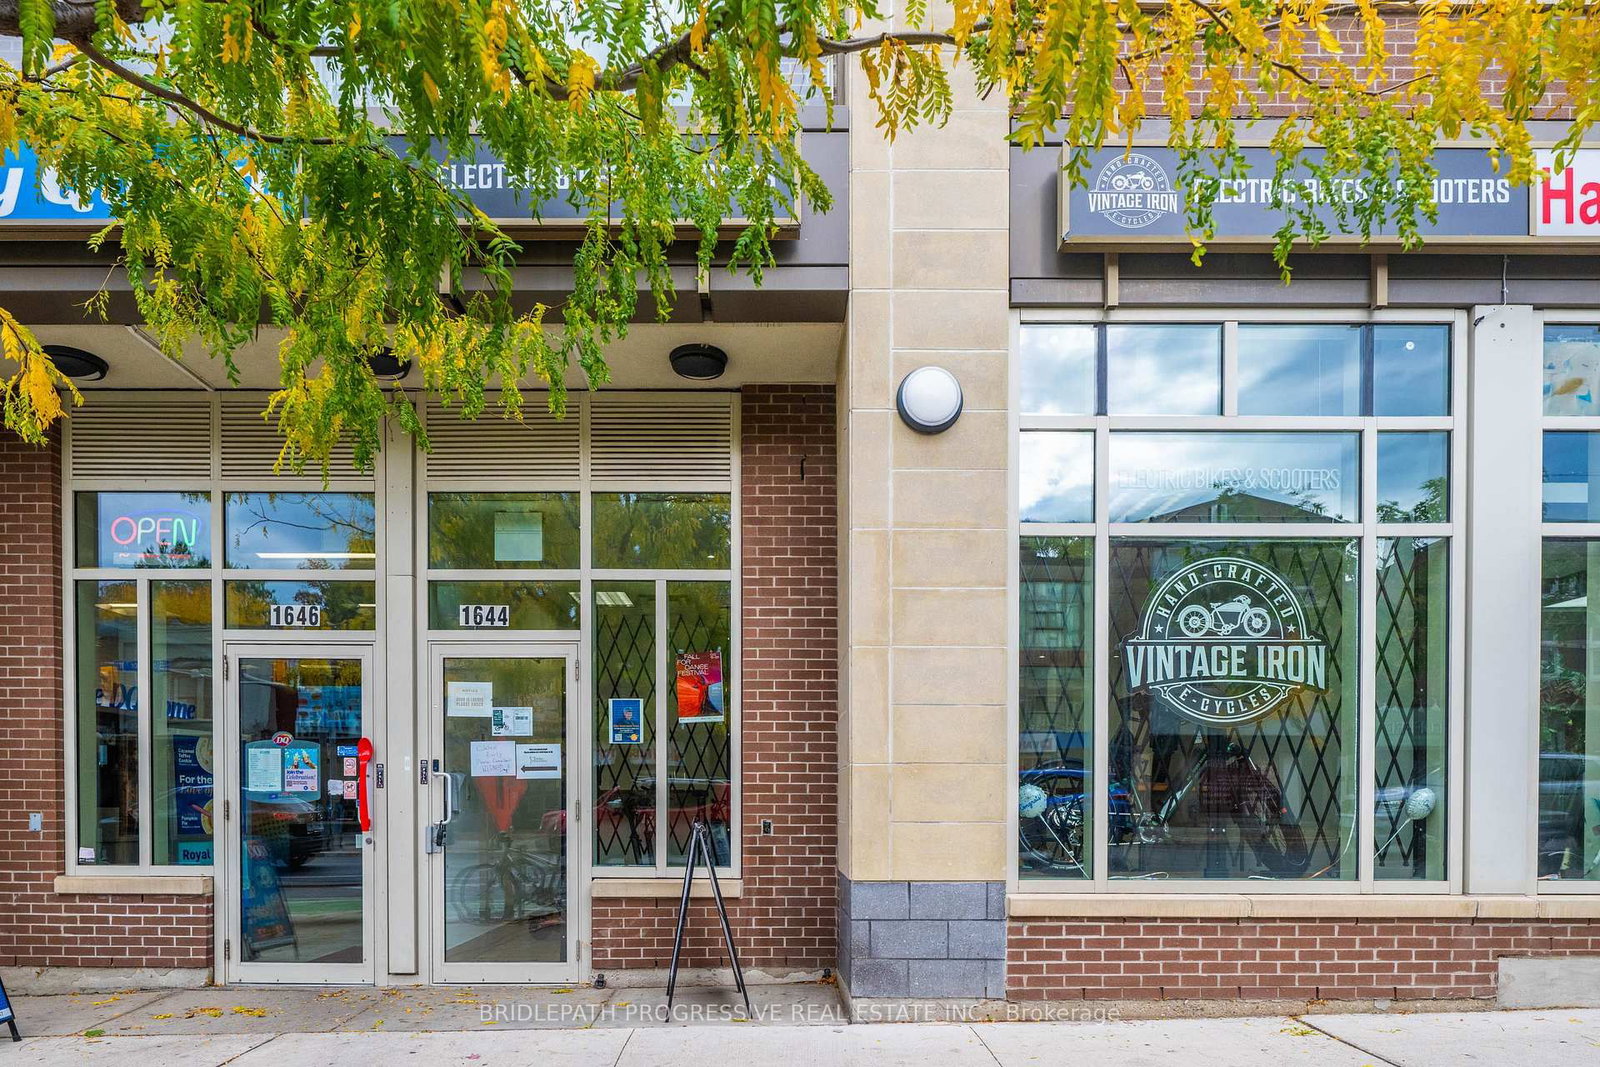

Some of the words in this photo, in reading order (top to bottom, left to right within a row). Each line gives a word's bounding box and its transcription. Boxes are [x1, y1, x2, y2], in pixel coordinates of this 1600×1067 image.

[1088, 193, 1143, 213] VINTAGE
[1147, 193, 1178, 214] IRON
[1112, 212, 1154, 225] E-CYCLES
[1118, 468, 1192, 489] ELECTRIC
[1197, 468, 1240, 489] BIKES
[1242, 469, 1258, 489] &
[1259, 467, 1340, 489] SCOOTERS
[111, 517, 197, 547] OPEN
[1156, 564, 1295, 618] HAND-CRAFTED
[272, 605, 319, 626] 1646
[462, 606, 508, 625] 1644
[1125, 645, 1248, 688] VINTAGE
[1257, 645, 1327, 690] IRON
[1179, 687, 1272, 715] E-CYCLES
[276, 734, 289, 744] DQ
[179, 775, 195, 784] For
[197, 775, 213, 784] the
[183, 848, 211, 863] Royal
